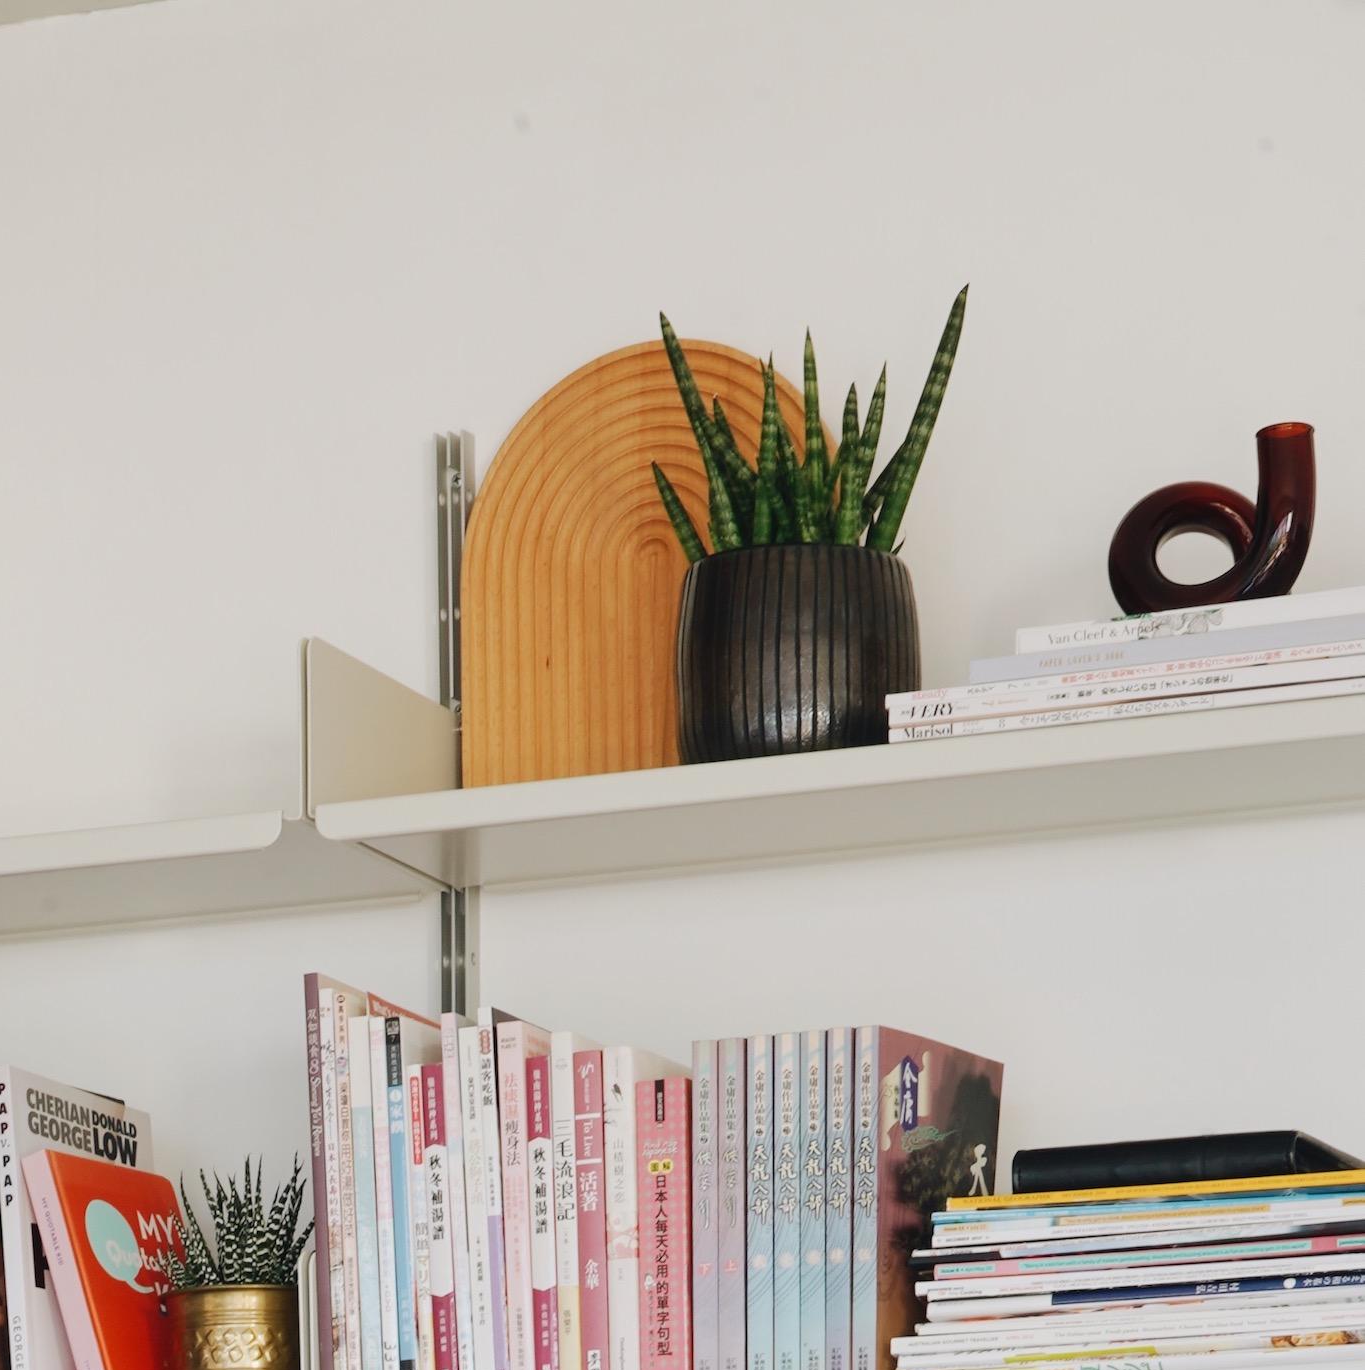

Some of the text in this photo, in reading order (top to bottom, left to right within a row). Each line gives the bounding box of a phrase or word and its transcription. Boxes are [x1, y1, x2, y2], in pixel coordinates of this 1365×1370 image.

[903, 724, 954, 738] Marisol
[26, 1088, 137, 1139] CHERIAN DONALD
[28, 1111, 137, 1167] GEORGE LOW
[555, 1120, 575, 1220] 三毛流浪記
